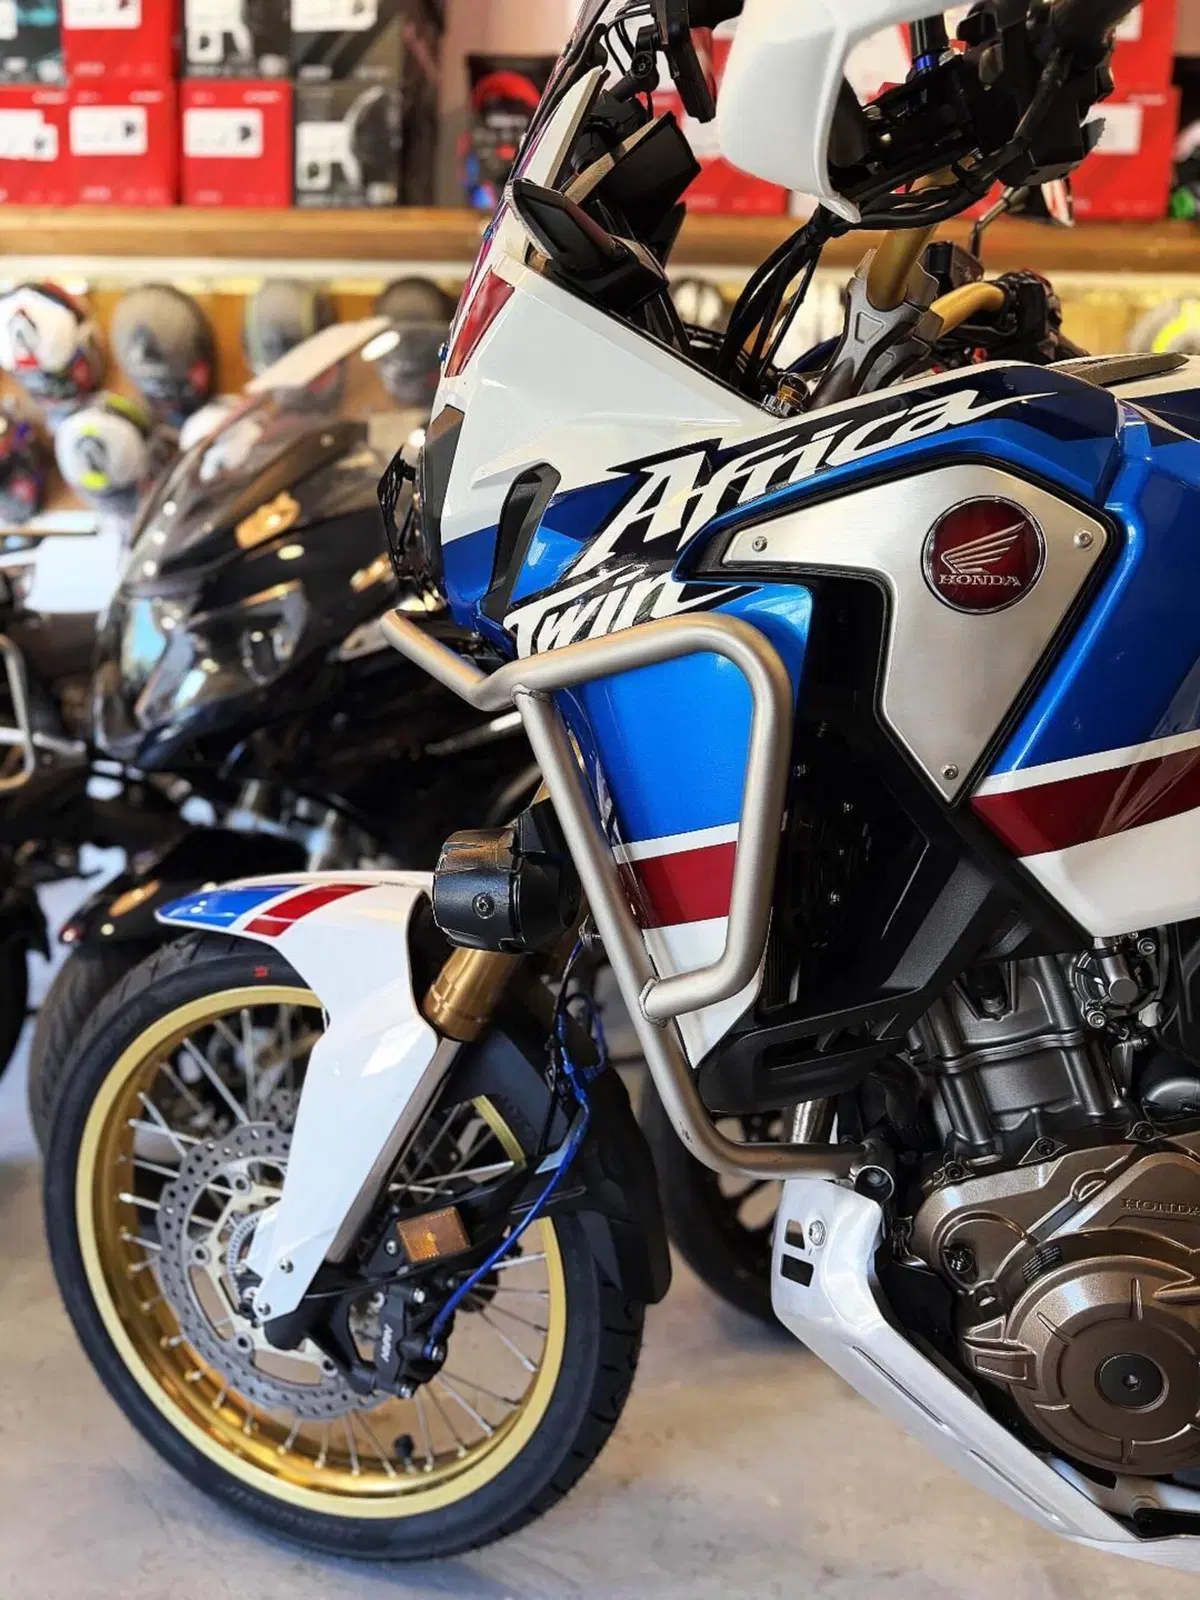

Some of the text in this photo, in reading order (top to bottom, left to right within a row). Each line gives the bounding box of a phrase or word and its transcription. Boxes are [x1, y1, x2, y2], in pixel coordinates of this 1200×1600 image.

[567, 389, 1058, 582] Africa
[502, 562, 742, 660] Twin
[938, 574, 1022, 587] HONDA
